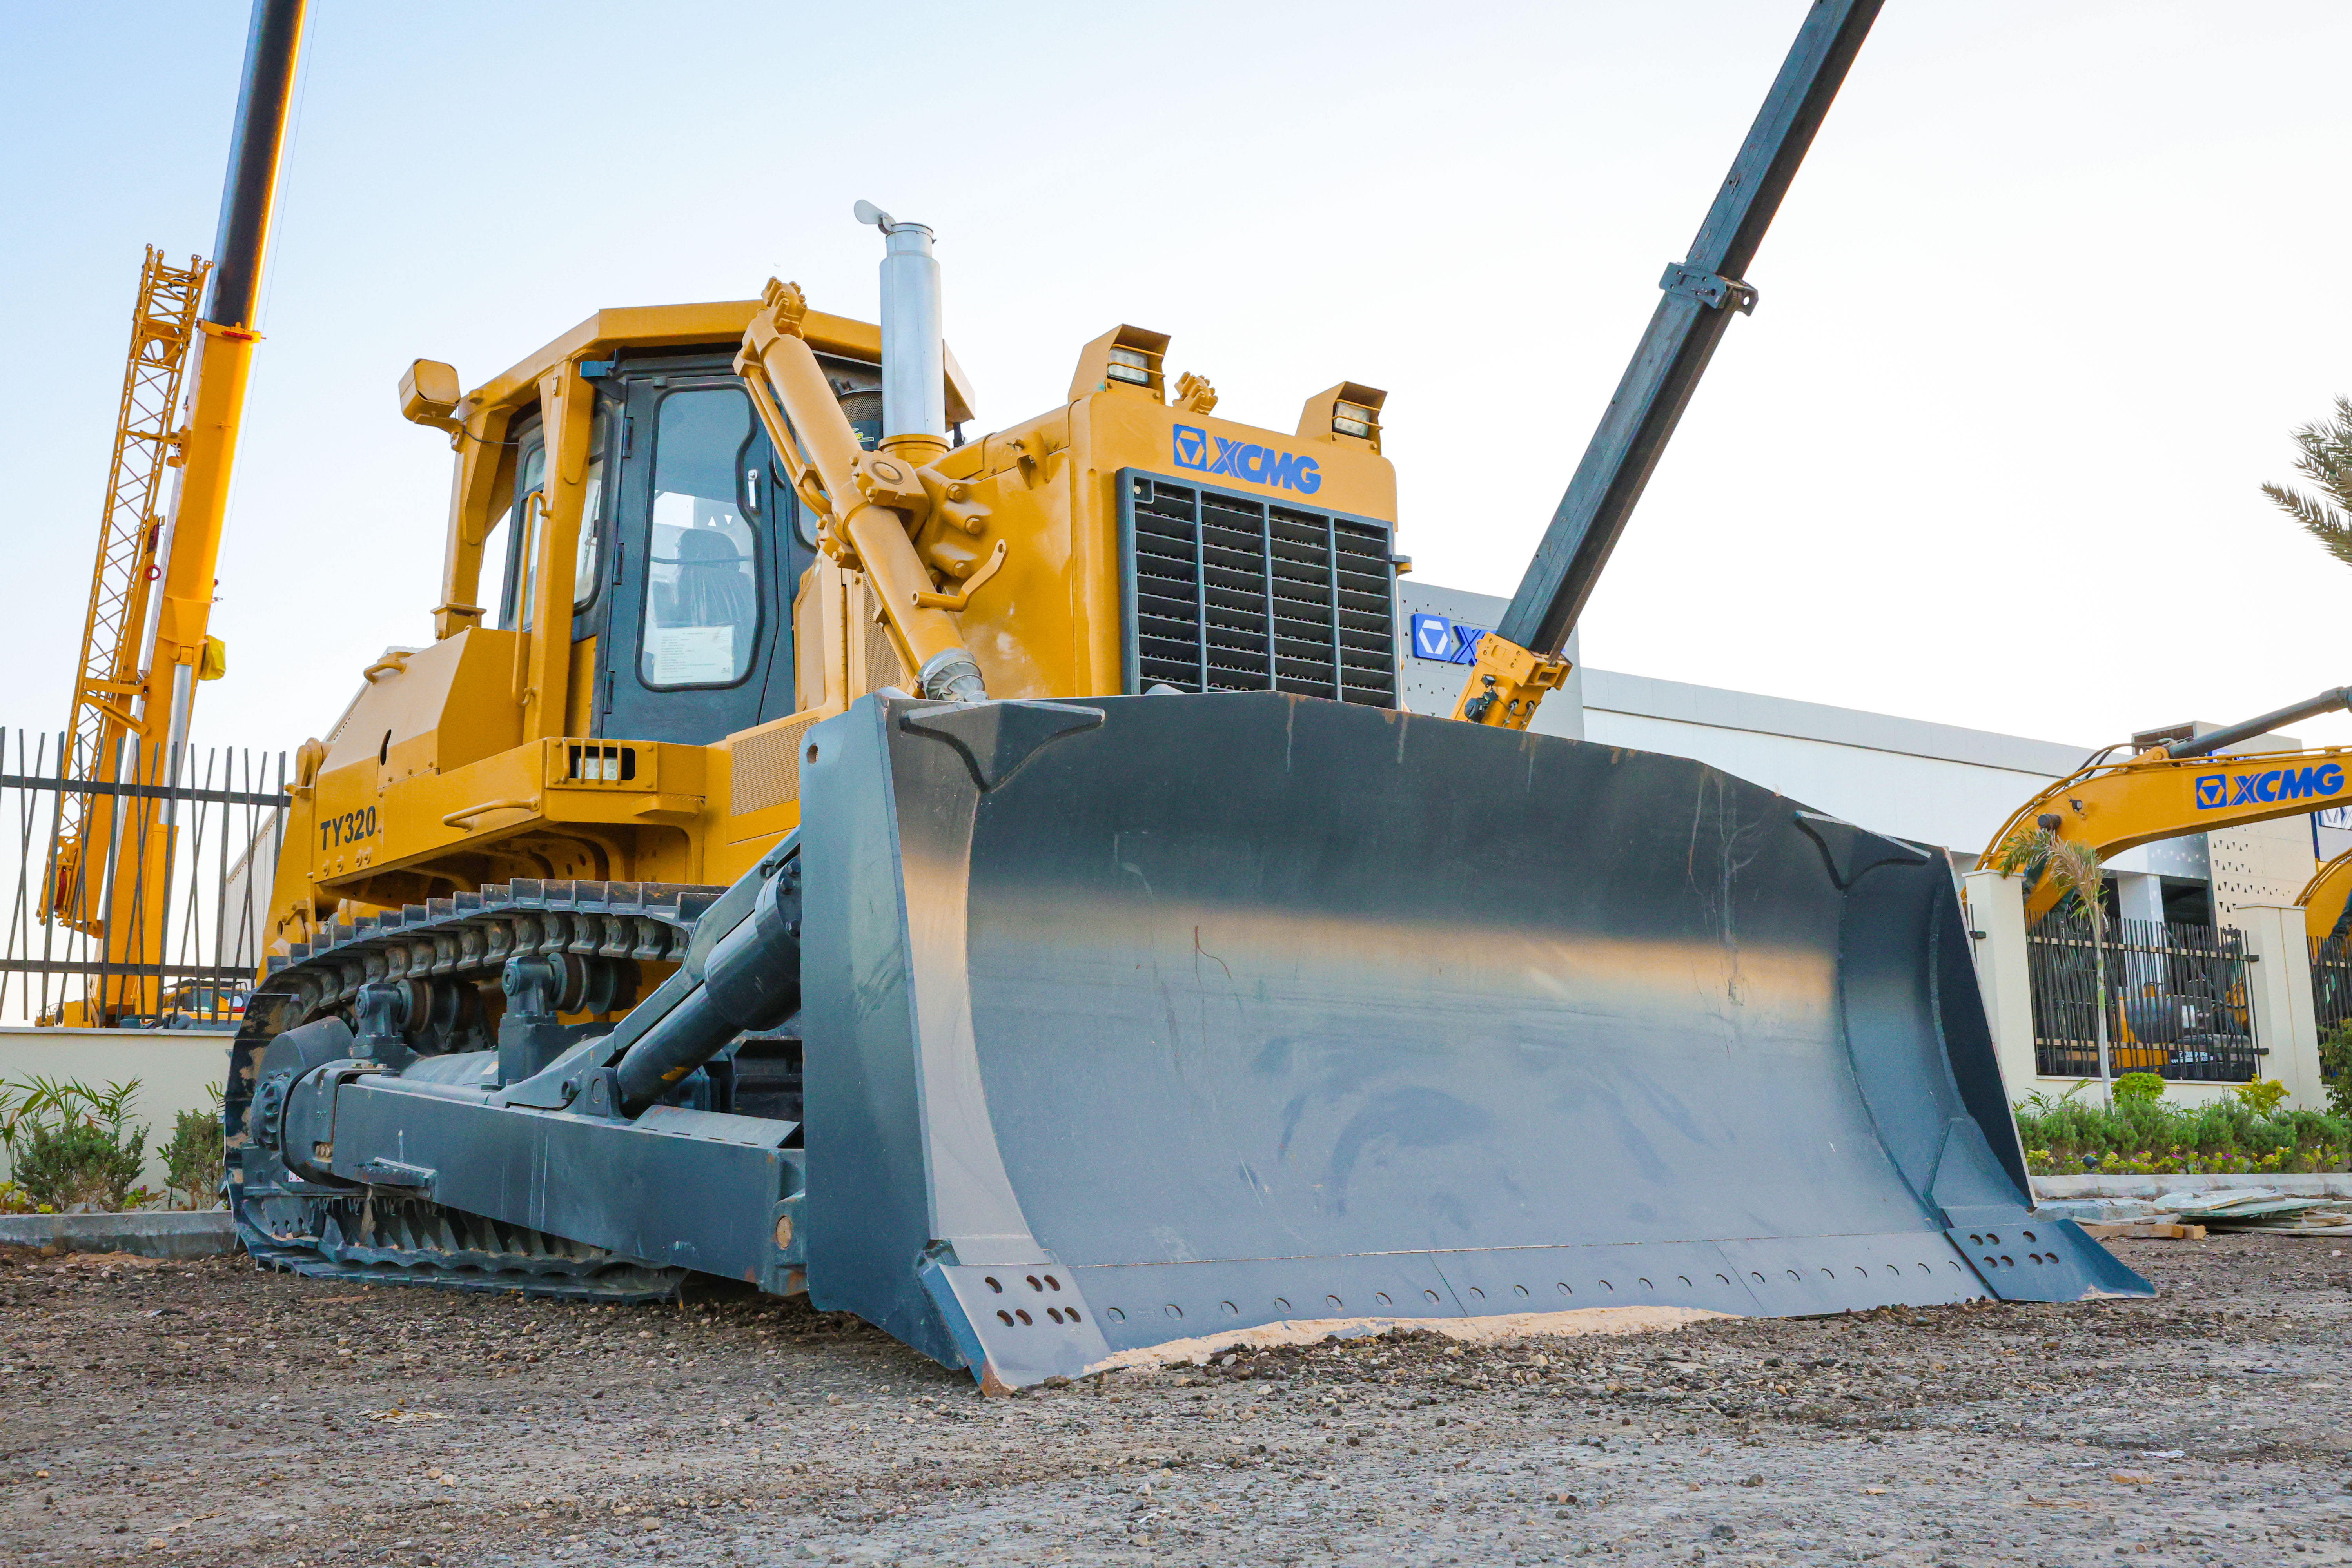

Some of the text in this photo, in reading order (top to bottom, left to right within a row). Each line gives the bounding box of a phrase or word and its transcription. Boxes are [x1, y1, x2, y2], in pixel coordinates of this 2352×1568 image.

[1207, 436, 1321, 494] XCMG
[2228, 763, 2345, 806] XCMG
[320, 806, 376, 851] TY320
